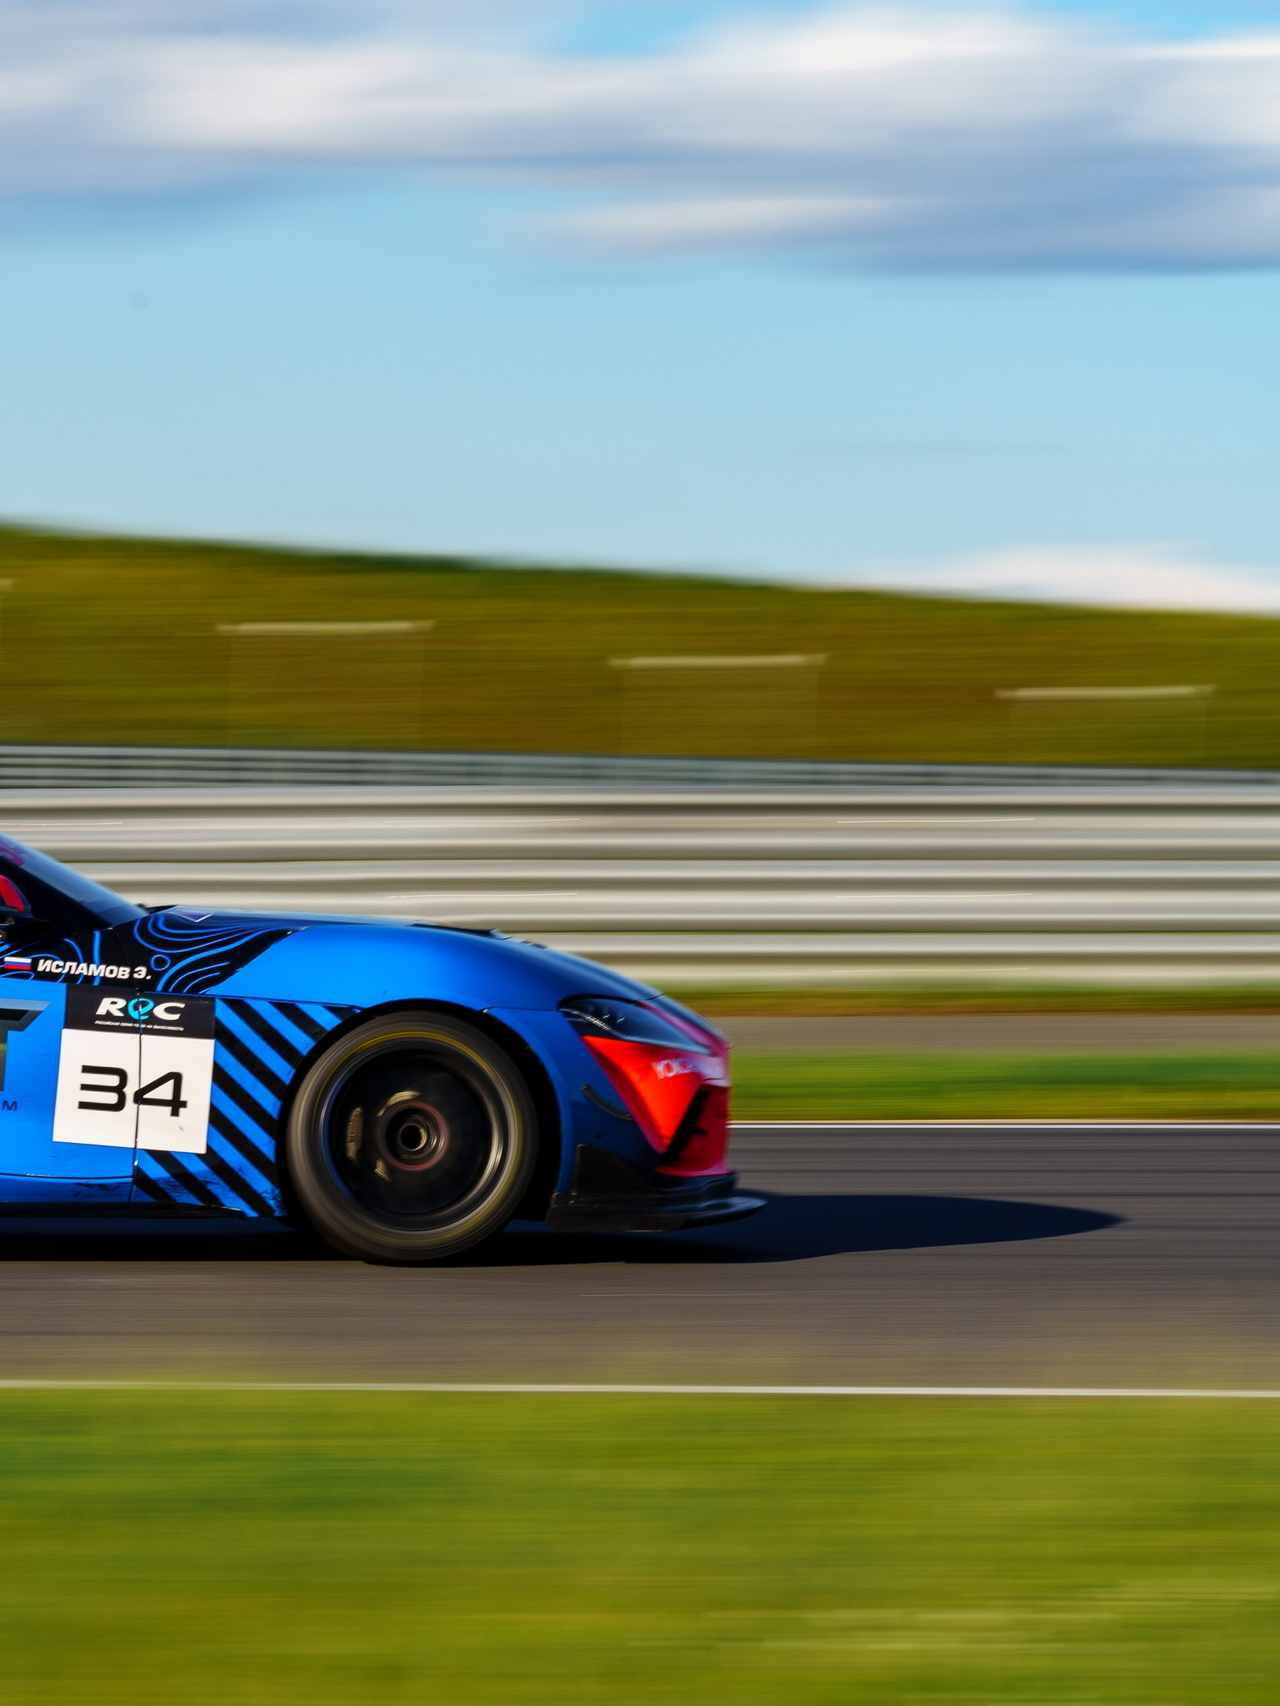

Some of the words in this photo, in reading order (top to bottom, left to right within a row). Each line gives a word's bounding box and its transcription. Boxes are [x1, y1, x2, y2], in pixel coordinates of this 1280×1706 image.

[37, 959, 131, 979] ИСЛАМОВ
[133, 966, 151, 980] Э.
[77, 1064, 188, 1117] 34
